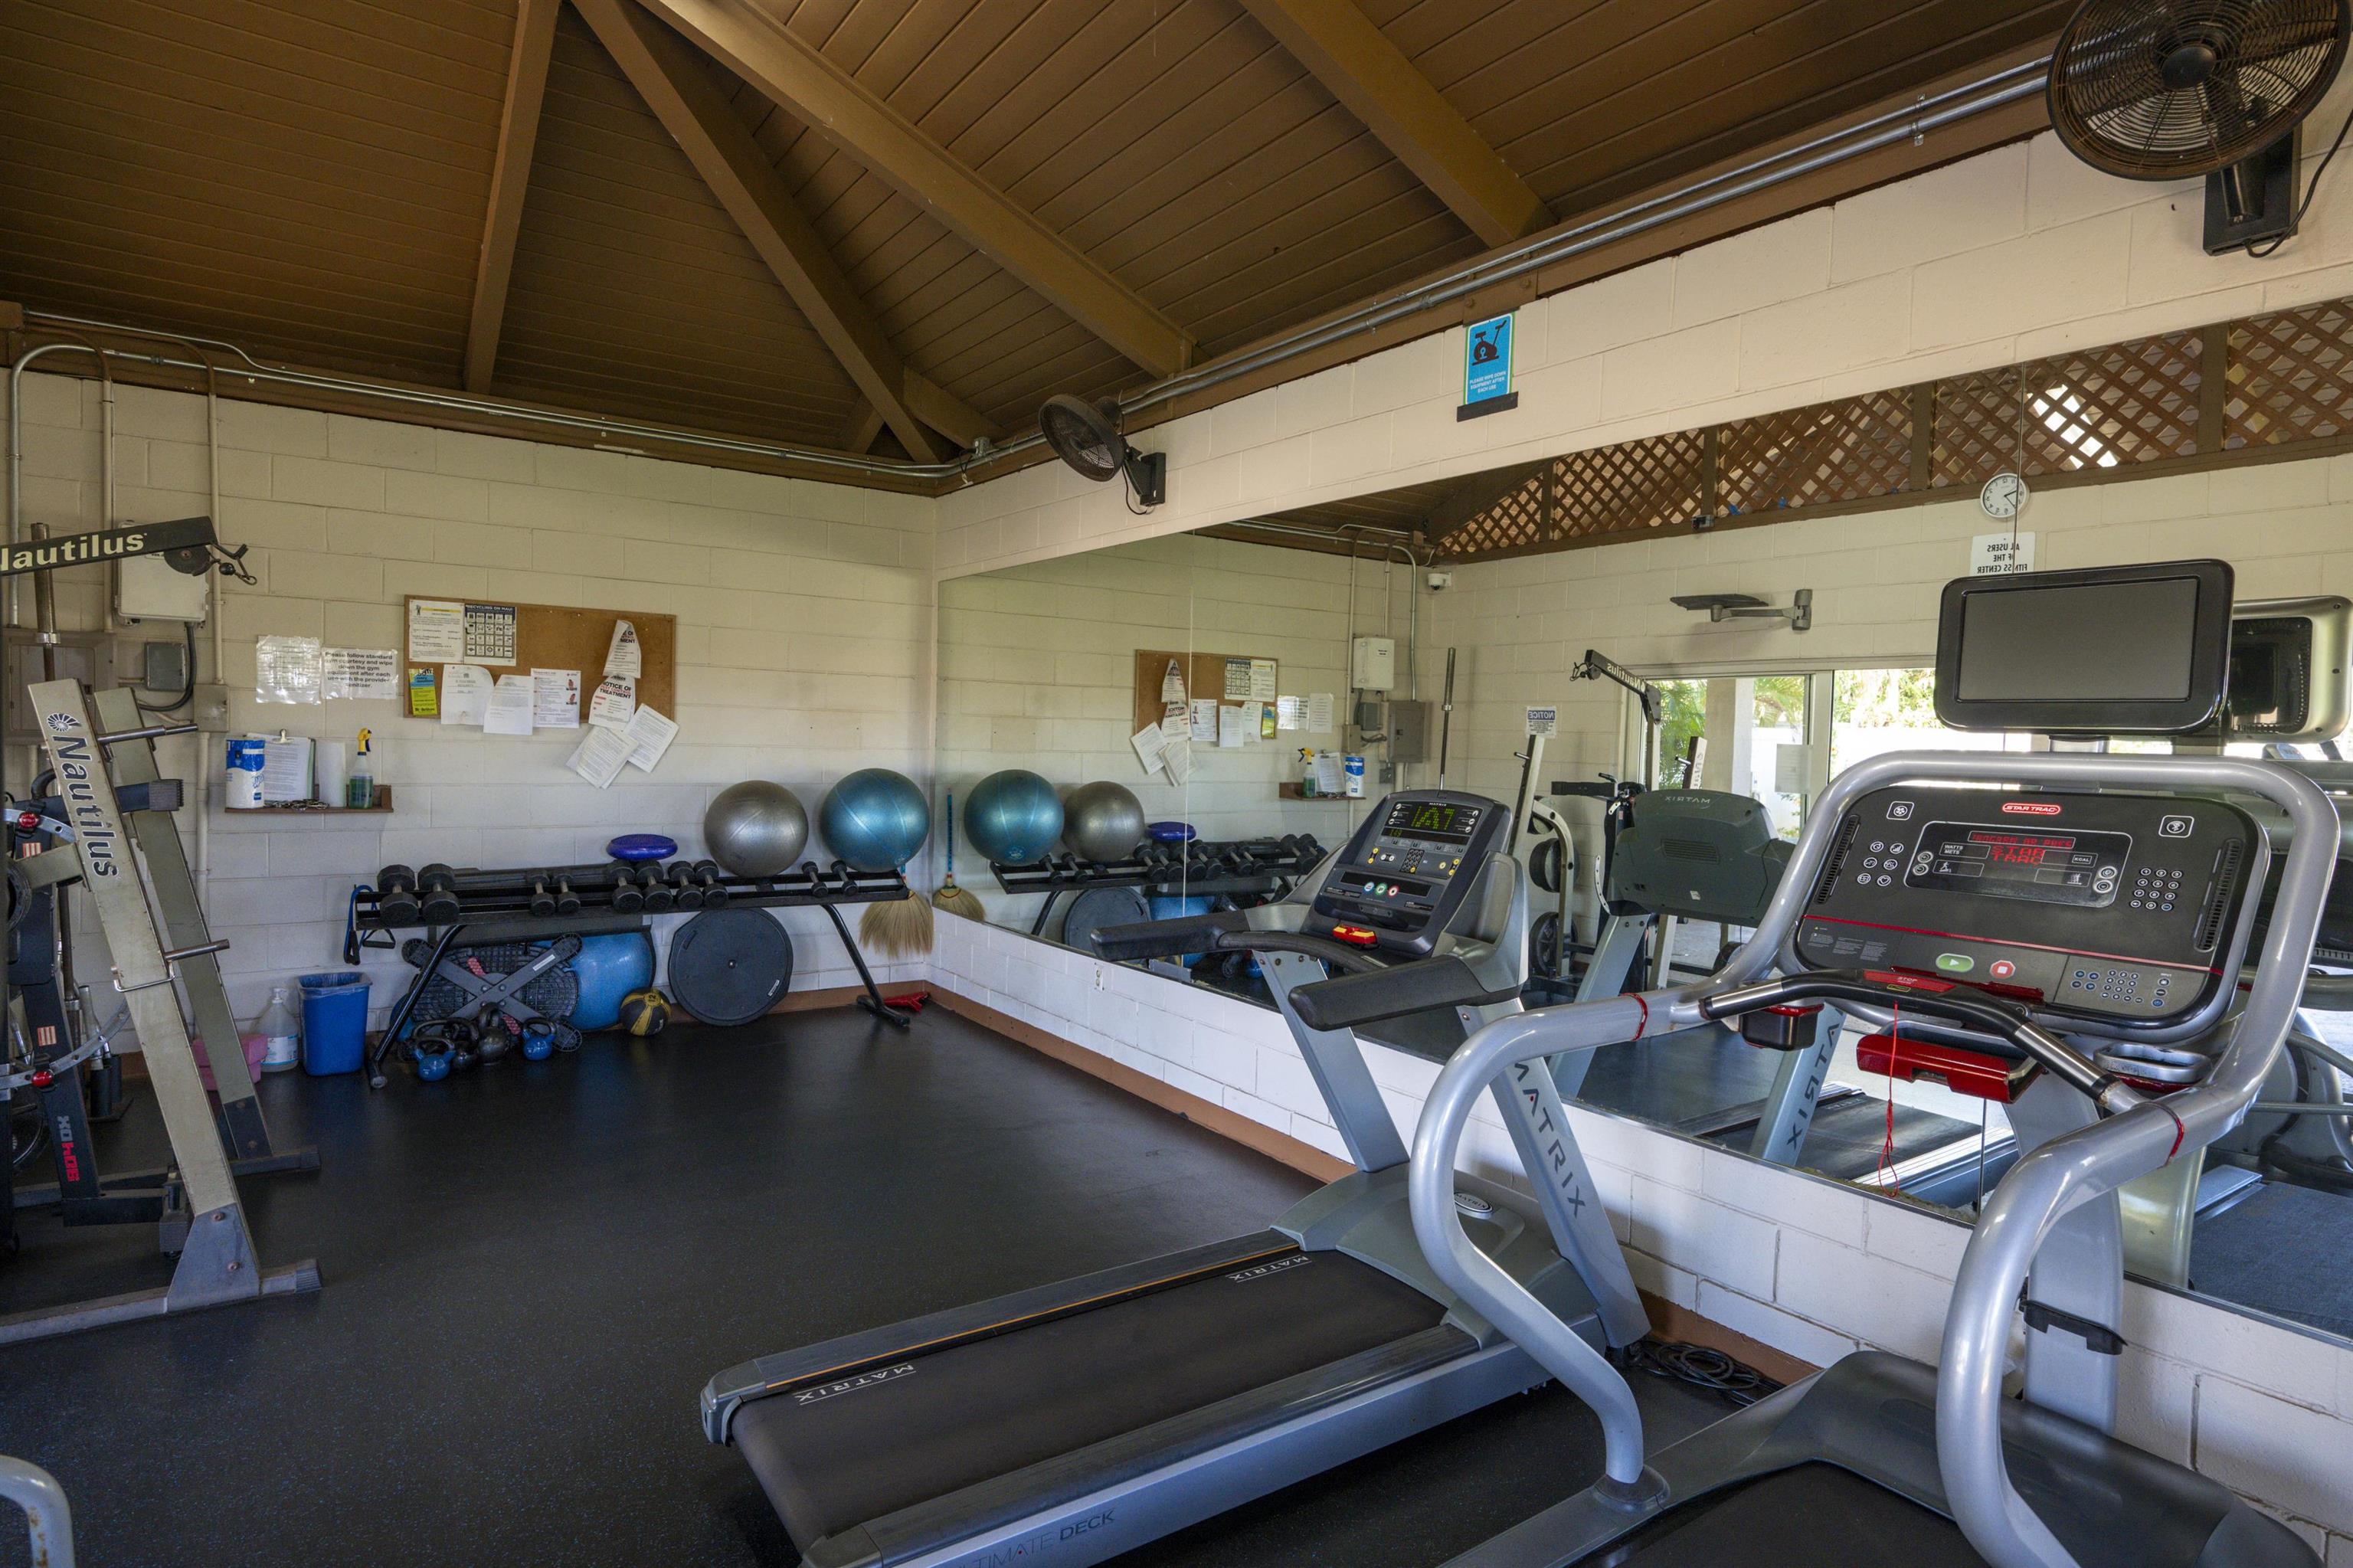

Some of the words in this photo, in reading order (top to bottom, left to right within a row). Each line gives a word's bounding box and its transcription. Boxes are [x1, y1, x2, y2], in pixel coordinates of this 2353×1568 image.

[1471, 381, 1491, 390] EQUIPMENT
[600, 688, 632, 699] TREATMENT
[52, 736, 118, 877] Nautilus
[1991, 845, 2045, 856] STAR
[1229, 1255, 1309, 1281] MATRIX
[794, 1364, 914, 1402] MATRIX
[959, 1534, 1054, 1568] TIMATE
[1060, 1510, 1114, 1541] DECK
